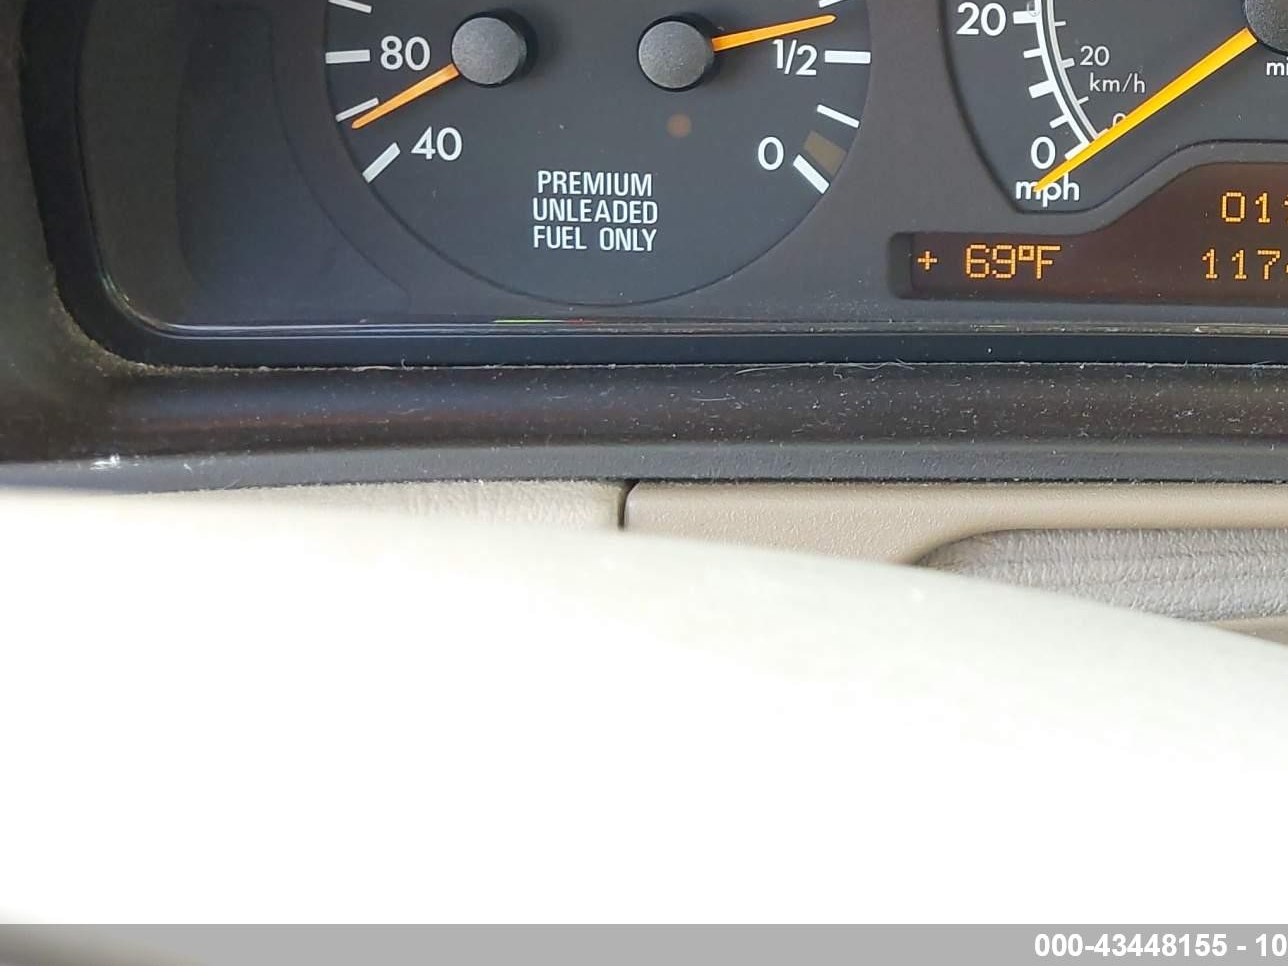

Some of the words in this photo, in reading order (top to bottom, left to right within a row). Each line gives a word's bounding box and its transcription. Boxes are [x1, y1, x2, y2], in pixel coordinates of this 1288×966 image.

[956, 1, 1007, 36] 20
[380, 35, 431, 71] 80
[773, 38, 818, 75] 1/2
[1079, 45, 1110, 67] 20
[1089, 72, 1146, 94] km/h
[411, 126, 462, 161] 40
[757, 136, 784, 171] 0
[1030, 136, 1056, 170] 0
[537, 170, 652, 197] PREMIUM
[1015, 172, 1080, 208] mph
[532, 197, 658, 224] UNLEADED
[533, 225, 588, 250] FUEL
[599, 227, 657, 252] ONLY
[917, 250, 938, 270] +
